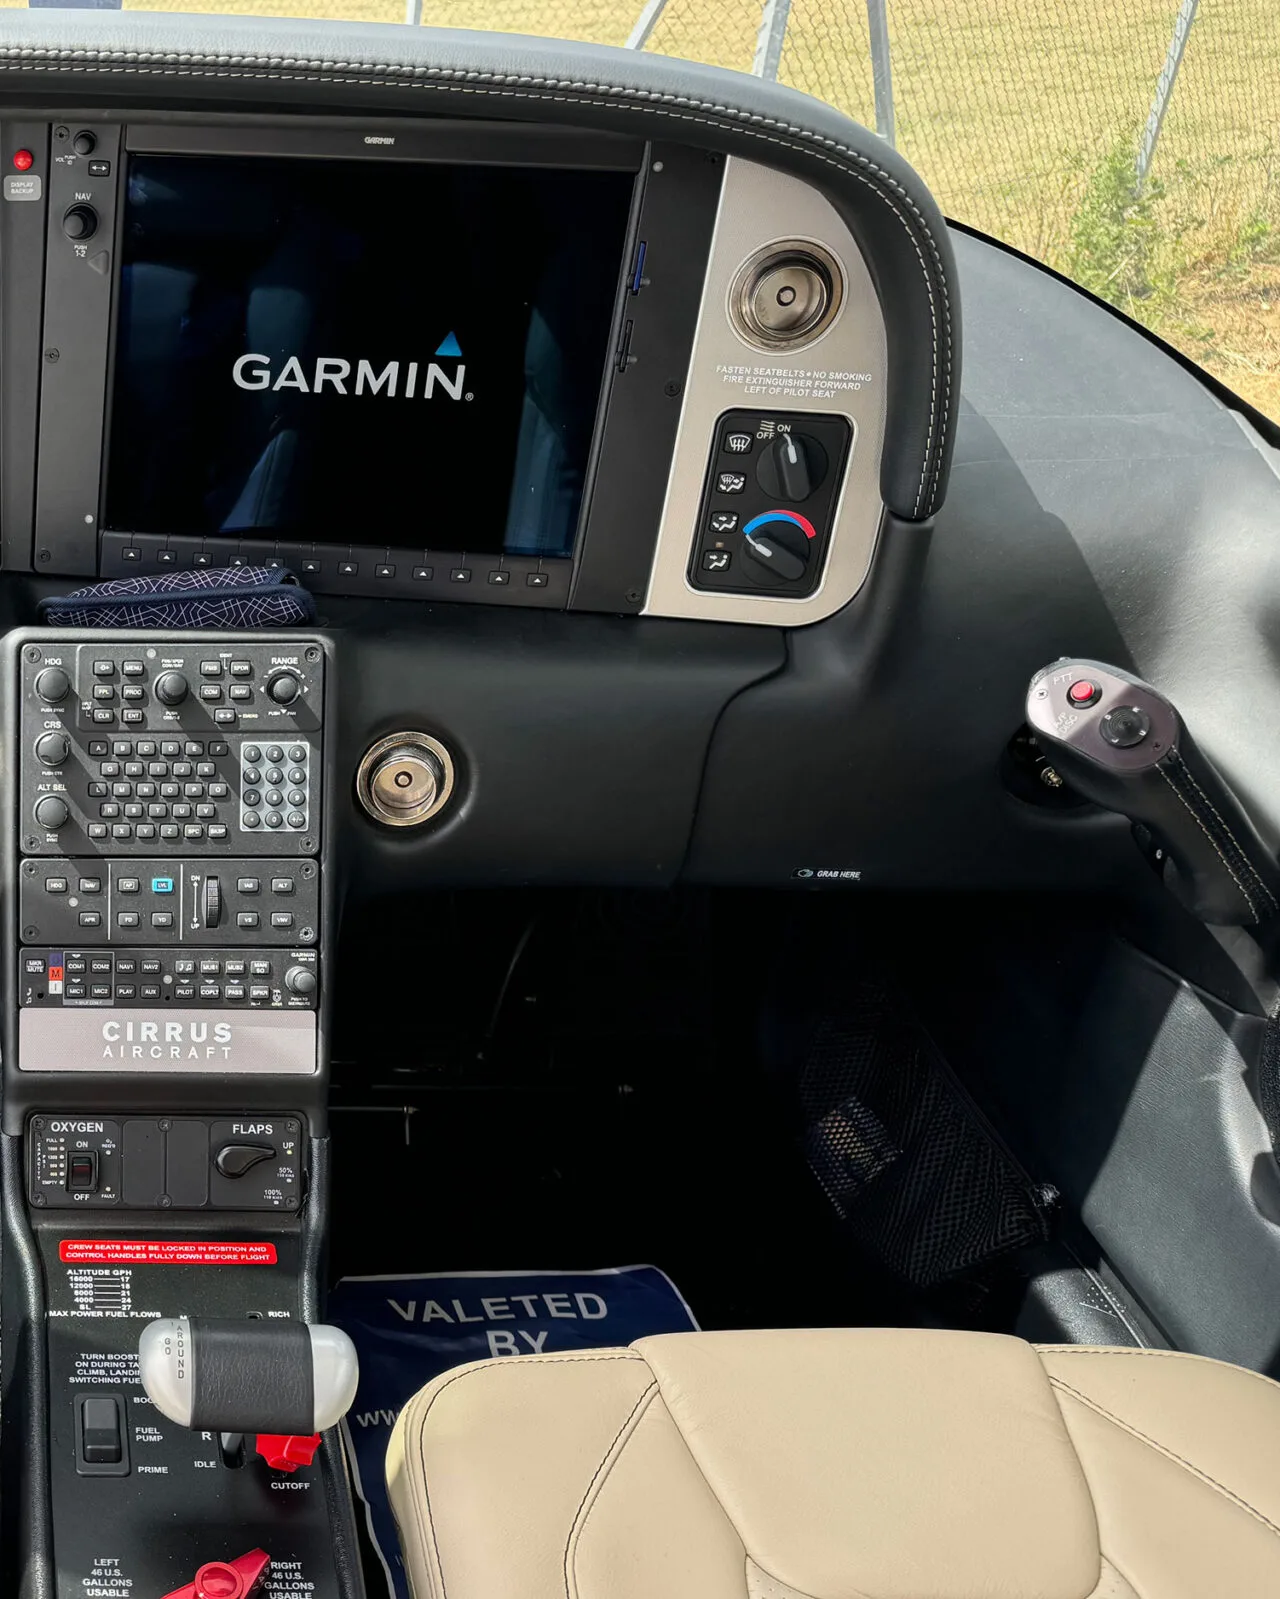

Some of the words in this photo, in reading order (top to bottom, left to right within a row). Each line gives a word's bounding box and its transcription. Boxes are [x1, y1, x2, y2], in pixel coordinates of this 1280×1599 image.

[364, 136, 395, 145] GARMIN
[75, 193, 91, 201] NAV
[75, 250, 86, 258] 1-2
[716, 365, 752, 375] FASTEN
[753, 367, 805, 378] SEATBELTS
[813, 370, 827, 379] NO
[828, 372, 872, 382] SMOKING
[723, 375, 744, 384] FIRE
[745, 376, 812, 388] EXTINGUISHER
[814, 380, 861, 391] FORWARD
[744, 385, 767, 394] LEFT
[768, 387, 782, 395] OF
[783, 388, 810, 397] PILOT
[811, 389, 836, 399] SEAT
[777, 424, 791, 433] ON
[756, 431, 775, 440] OFF
[44, 658, 62, 666] HDG
[271, 657, 298, 665] RANGE
[43, 721, 62, 729] CRS
[817, 870, 839, 878] GRAB
[839, 871, 861, 879] HERE
[102, 1020, 232, 1043] CIRRUS
[102, 1045, 232, 1060] AIRCRAFT
[50, 1121, 104, 1133] OXYGEN
[232, 1124, 273, 1135] FLAPS
[387, 1292, 608, 1323] VALETED
[486, 1329, 549, 1358] BY
[107, 1353, 139, 1361] BOOST
[194, 1461, 217, 1469] IDLE
[270, 1482, 311, 1490] CUTOFF
[94, 1558, 120, 1567] LEFT
[270, 1561, 302, 1570] RIGHT
[91, 1569, 103, 1577] 46
[104, 1569, 123, 1577] U.S.
[272, 1572, 284, 1580] 46
[285, 1572, 304, 1580] U.S.
[82, 1578, 133, 1588] GALLONS
[265, 1581, 315, 1590] GALLONS
[86, 1588, 130, 1598] USABLE
[269, 1591, 312, 1599] USABLE
